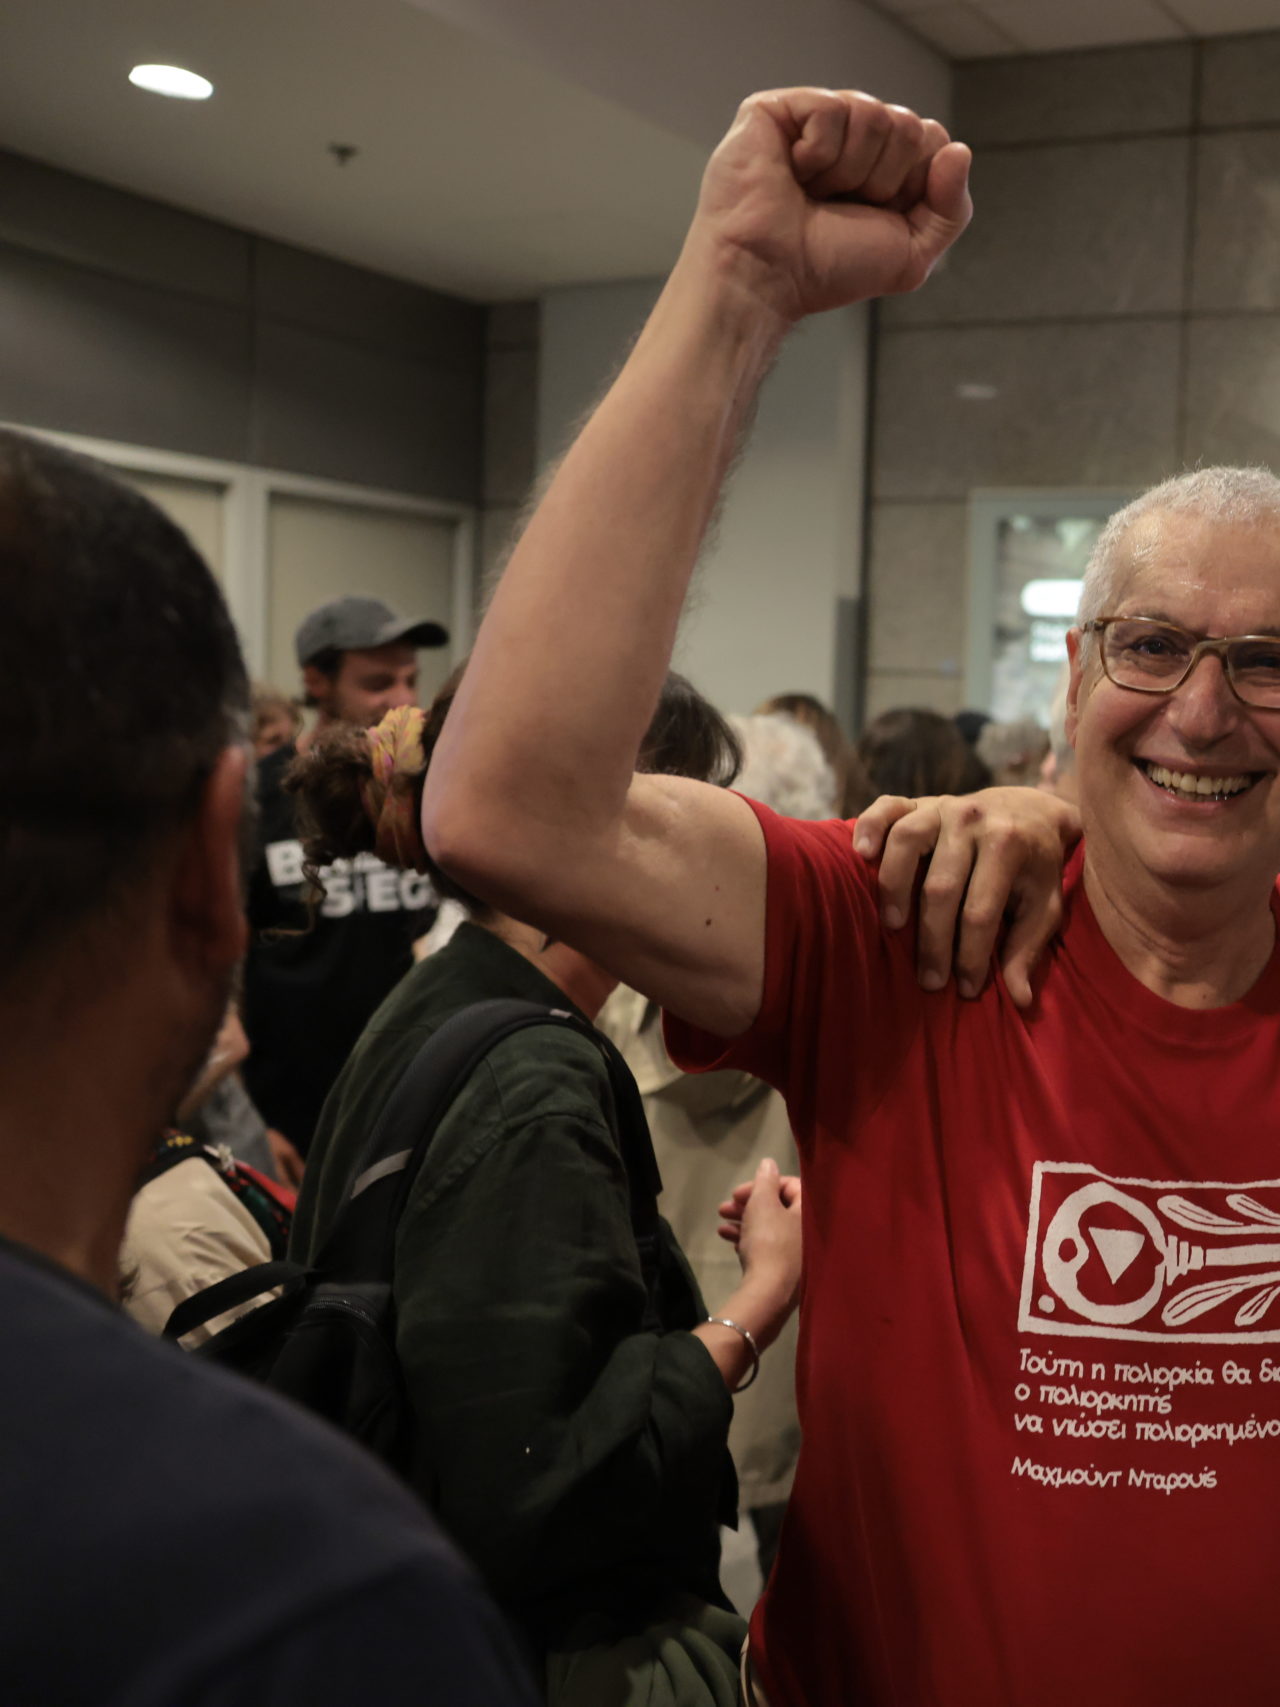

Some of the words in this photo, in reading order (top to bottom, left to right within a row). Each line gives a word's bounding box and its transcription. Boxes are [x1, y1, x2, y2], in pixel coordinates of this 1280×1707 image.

[320, 866, 436, 918] SIEG
[1019, 1348, 1084, 1379] Τούτη
[1090, 1362, 1106, 1381] η
[1113, 1360, 1215, 1392] πολιορκία
[1221, 1359, 1252, 1385] θα
[1039, 1384, 1173, 1417] πολιορκητής
[1013, 1413, 1044, 1434] να
[1051, 1411, 1127, 1441] νιώσει
[1010, 1456, 1123, 1489] Μαχμούντ
[1127, 1465, 1218, 1496] Νταρουίς
